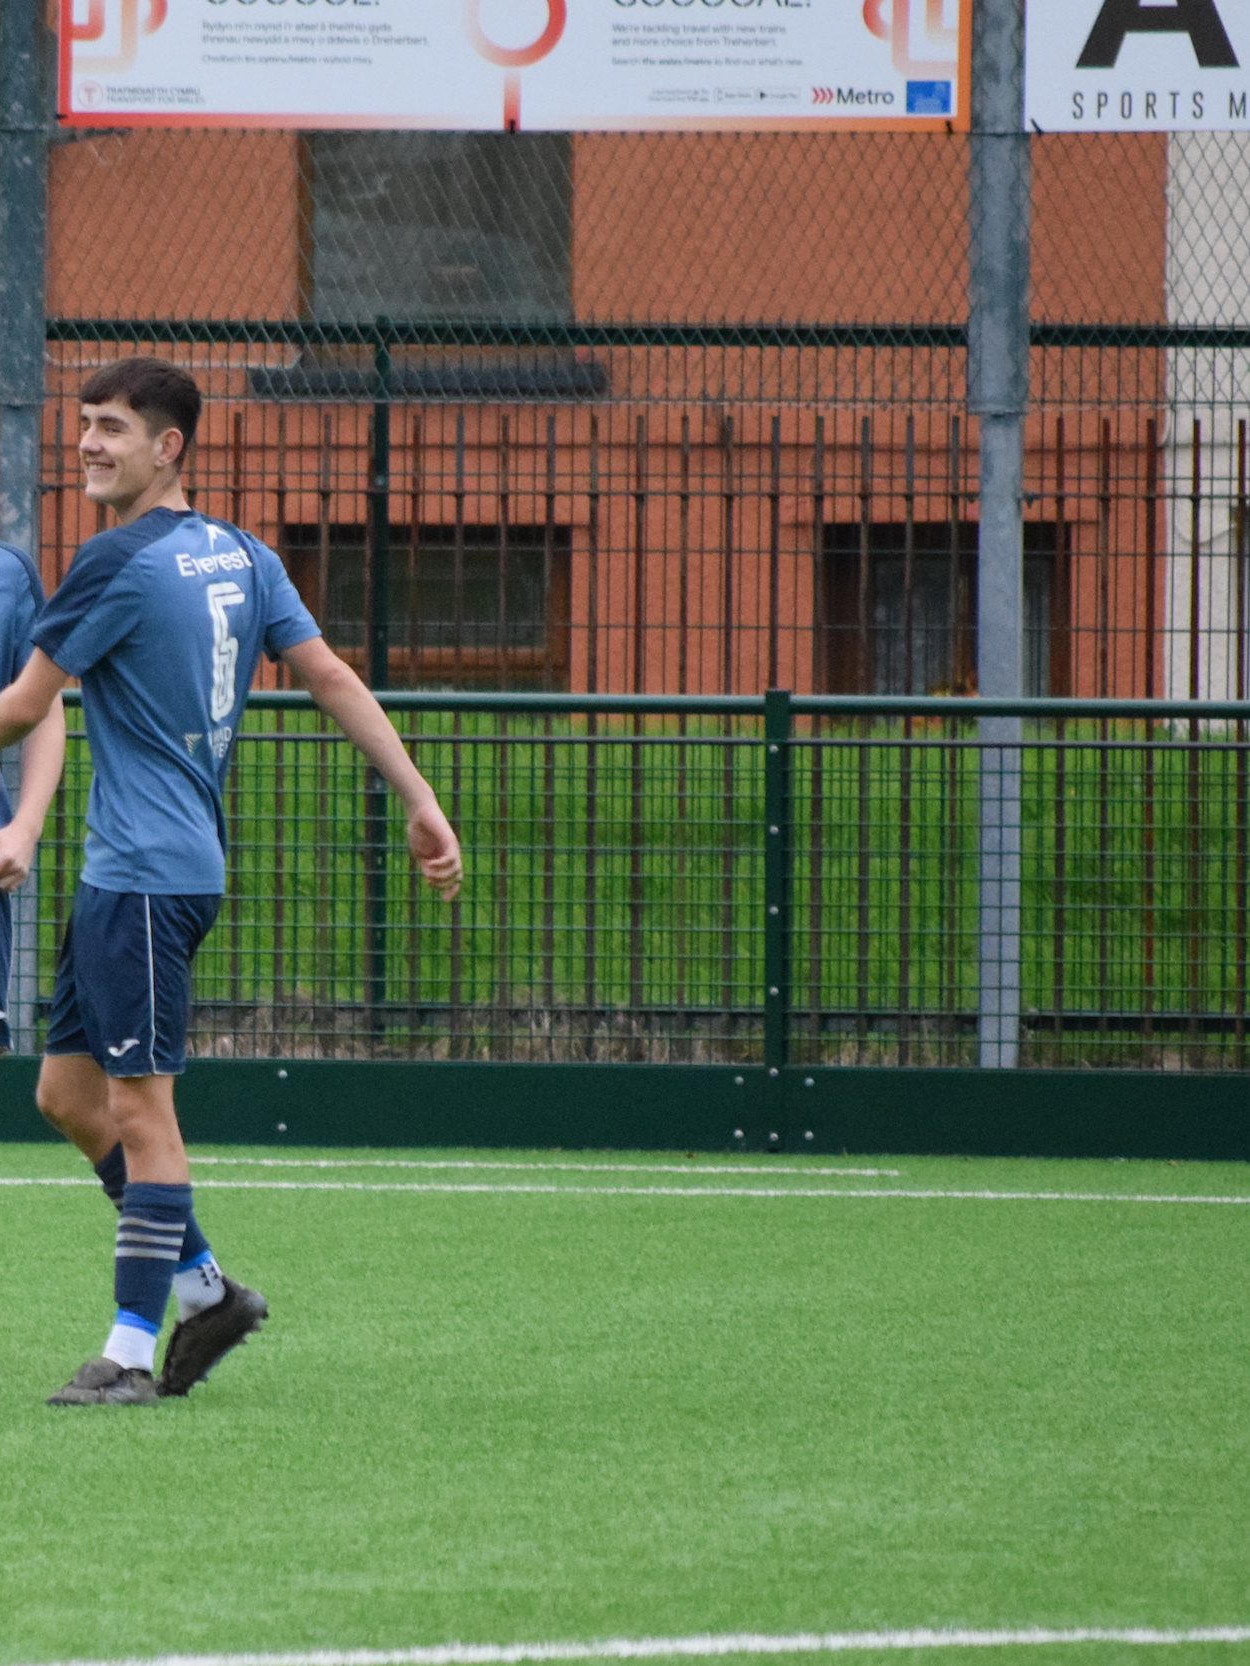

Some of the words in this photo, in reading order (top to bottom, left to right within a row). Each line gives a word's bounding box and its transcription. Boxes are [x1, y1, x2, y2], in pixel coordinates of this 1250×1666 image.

[712, 23, 734, 34] with
[612, 36, 631, 47] and
[632, 38, 659, 47] more
[661, 36, 694, 48] choice
[695, 36, 720, 48] from
[836, 88, 895, 105] Metro
[1072, 90, 1204, 120] SPORTS
[175, 548, 253, 577] Everest
